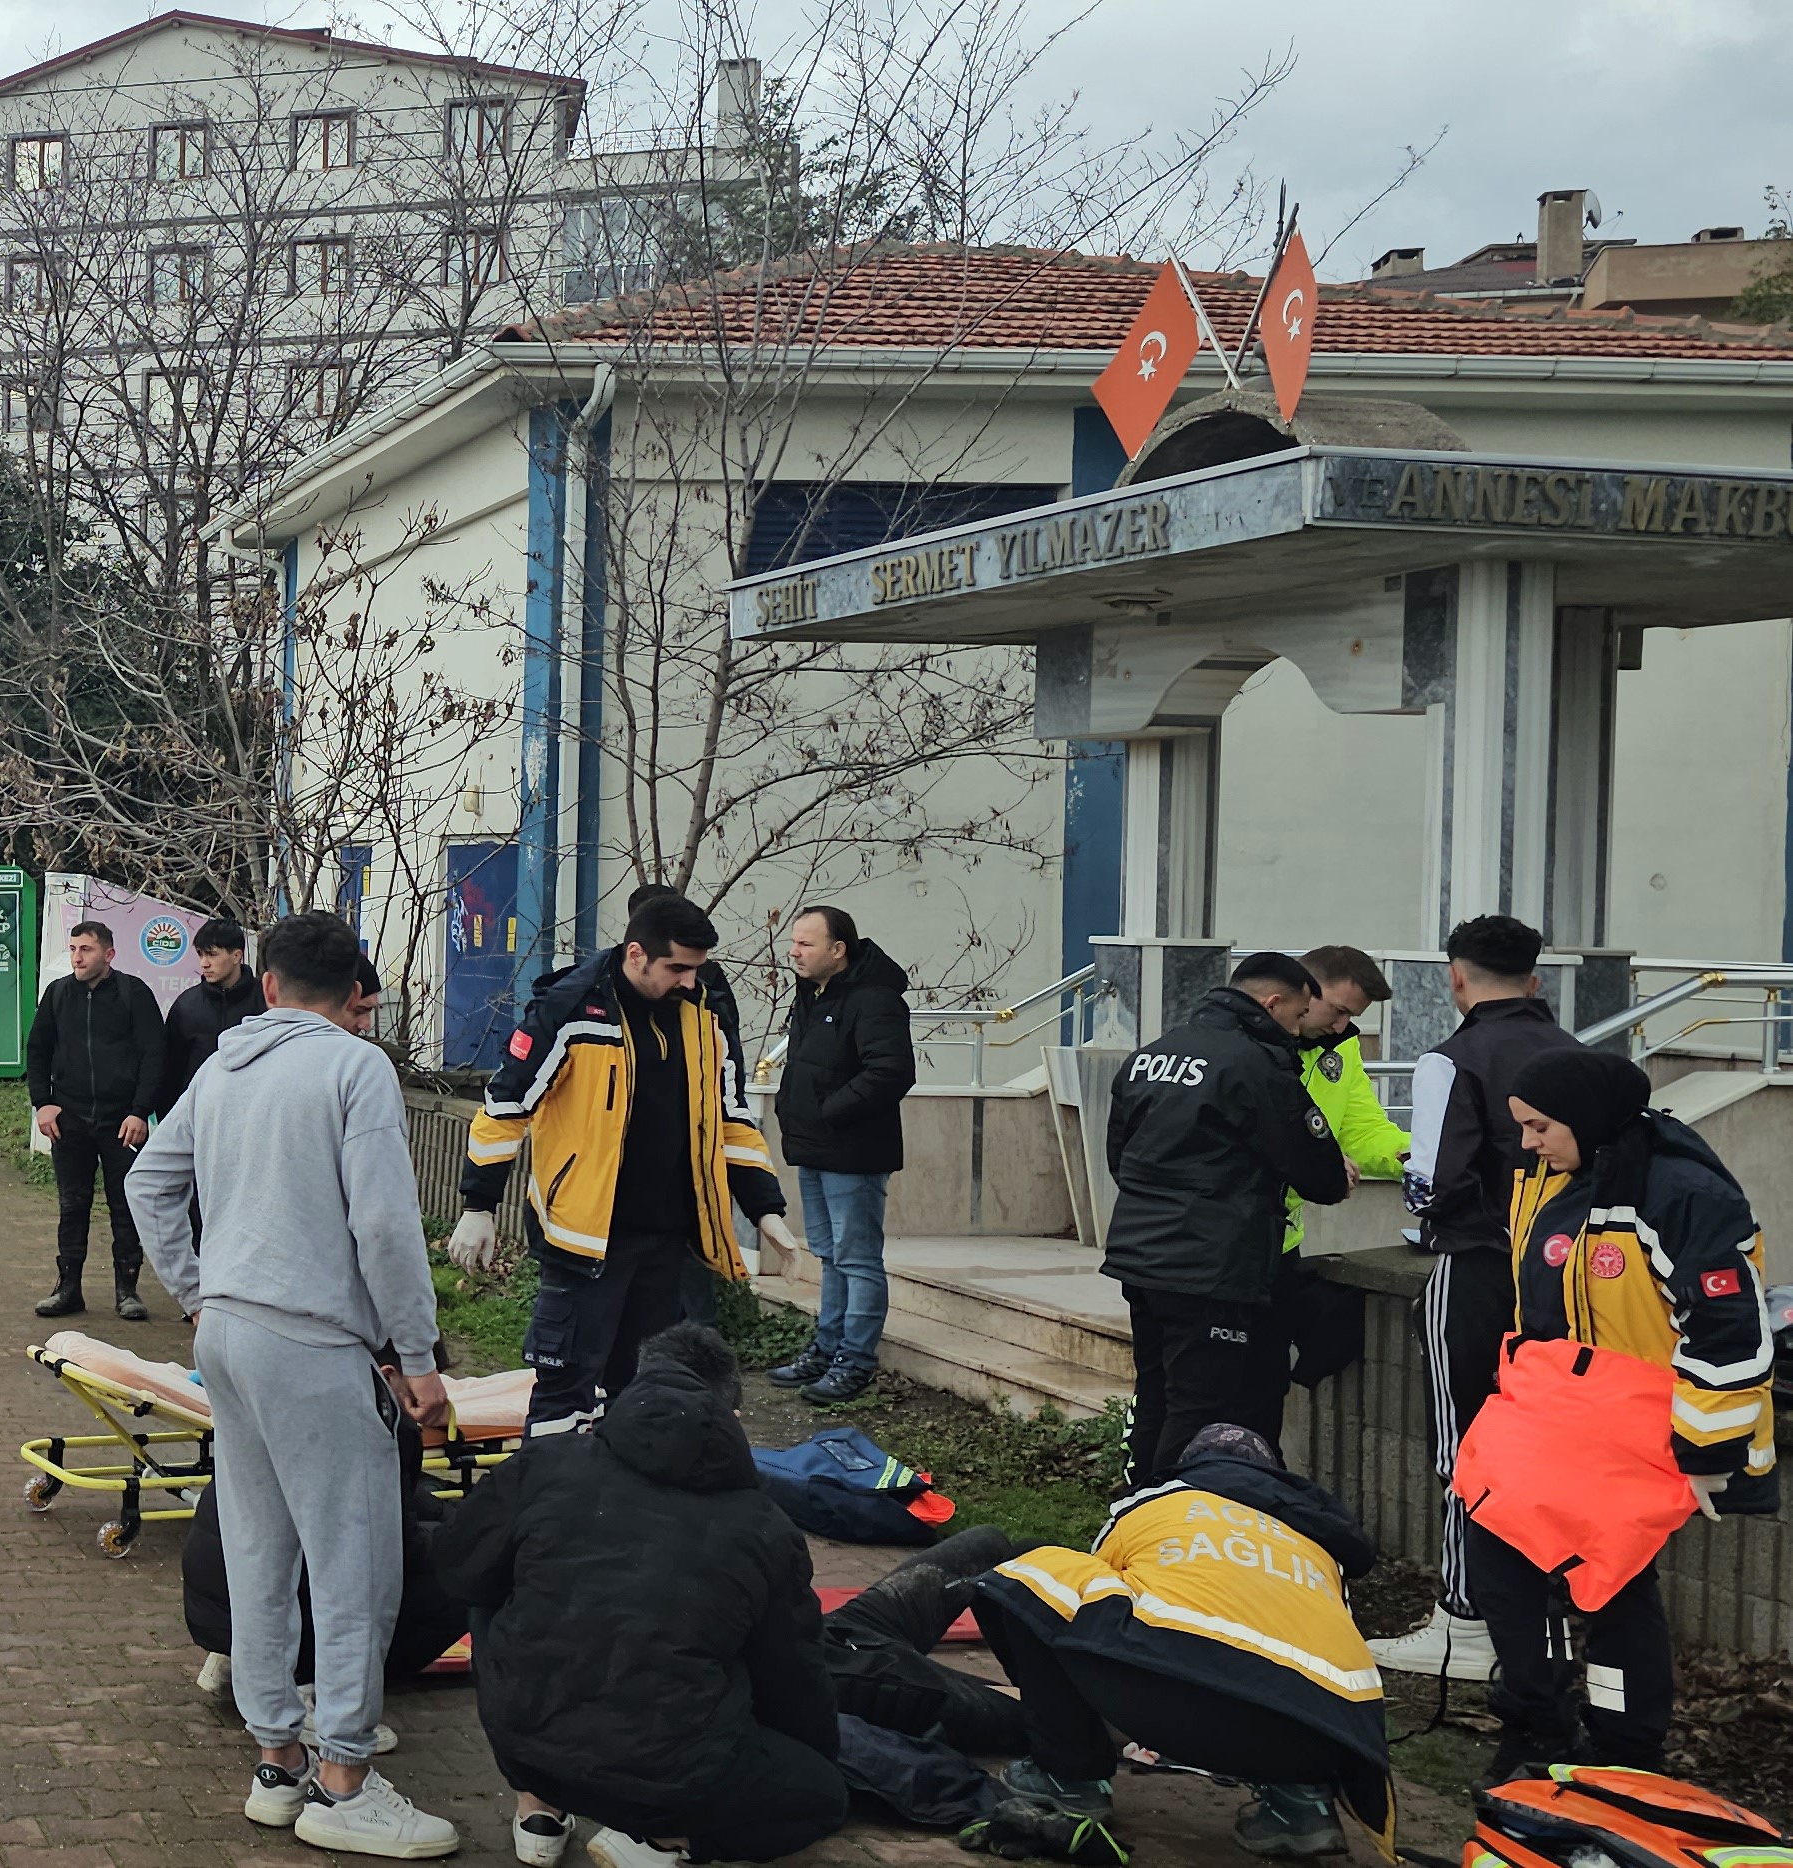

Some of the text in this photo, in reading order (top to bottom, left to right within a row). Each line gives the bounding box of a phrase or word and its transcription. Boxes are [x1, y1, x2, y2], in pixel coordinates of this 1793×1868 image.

[1618, 475, 1793, 538] MAKB
[871, 541, 980, 606] SERMET
[996, 500, 1171, 579] YILMAZER
[1158, 1529, 1335, 1601] SAĞLIK
